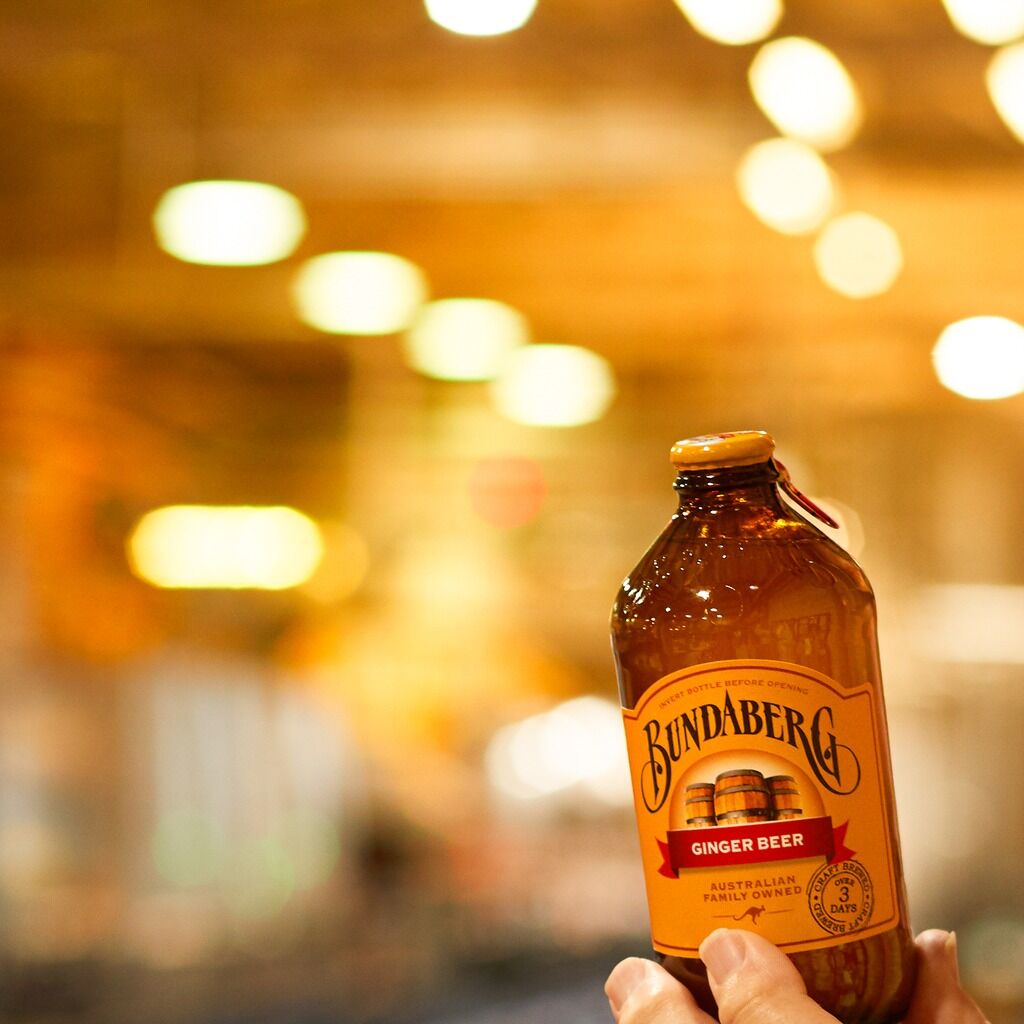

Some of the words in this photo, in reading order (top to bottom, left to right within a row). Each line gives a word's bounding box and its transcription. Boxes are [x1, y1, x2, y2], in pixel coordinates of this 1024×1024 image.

[659, 691, 685, 709] INVERT
[687, 681, 721, 696] BOTTLE
[725, 679, 765, 688] BEFORE
[767, 680, 809, 695] OPENING
[641, 689, 861, 814] BUNDABERG
[691, 839, 753, 856] GINGER
[757, 833, 804, 850] BEER
[710, 875, 796, 891] AUSTRALIAN
[815, 864, 839, 892] CRAFT
[842, 862, 870, 892] BREWED
[834, 878, 855, 887] OVER
[703, 891, 748, 903] FAMILY
[752, 885, 802, 900] OWNED
[838, 886, 849, 903] 3
[814, 903, 845, 932] BREWED
[830, 903, 857, 914] DAYS
